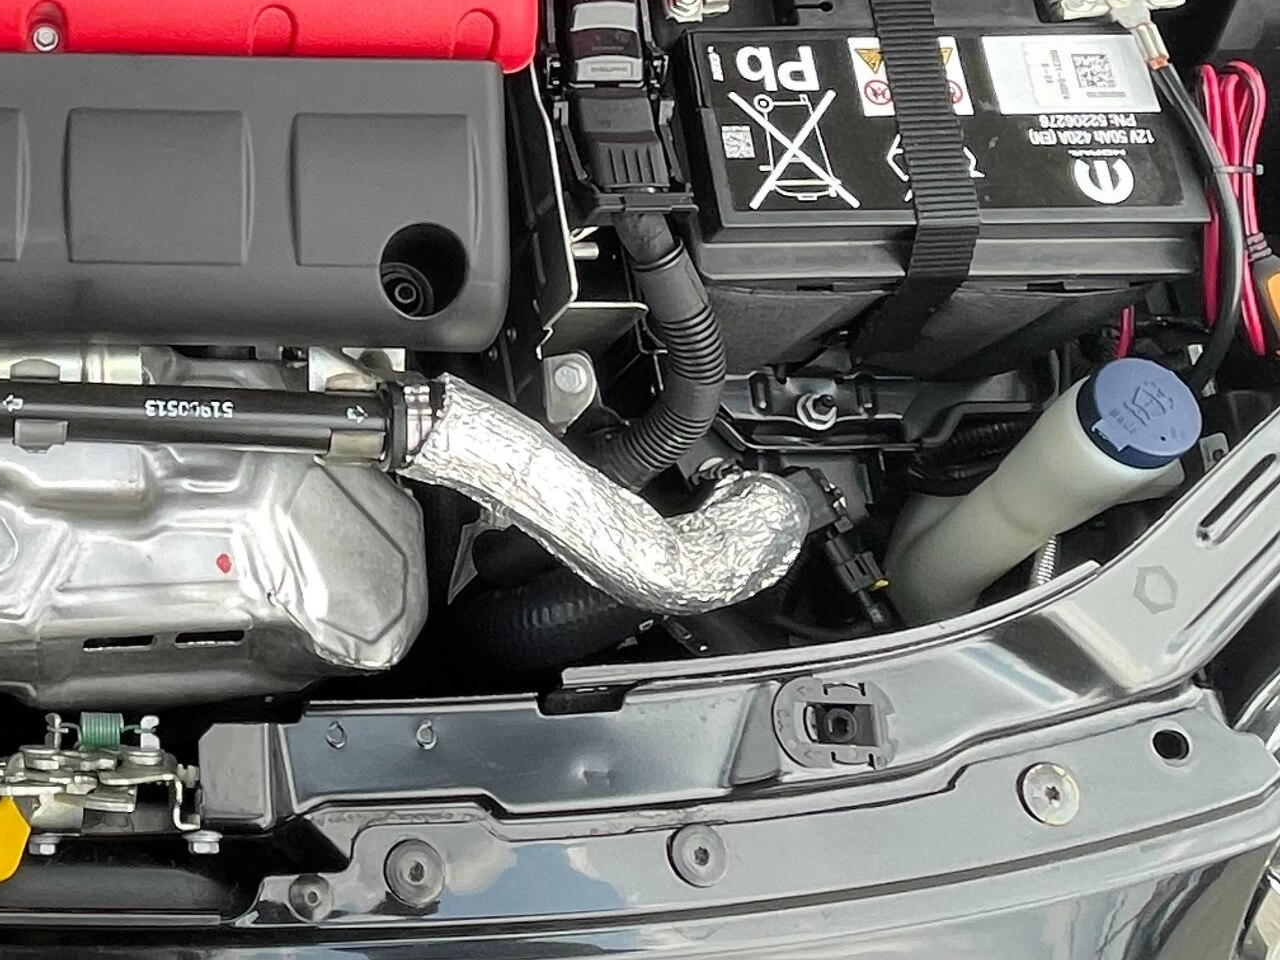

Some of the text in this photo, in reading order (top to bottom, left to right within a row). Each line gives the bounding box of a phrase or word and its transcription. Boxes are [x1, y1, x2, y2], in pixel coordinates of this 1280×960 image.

[736, 45, 820, 92] Pb
[1093, 129, 1129, 145] 50Ah
[1129, 129, 1156, 144] 12V
